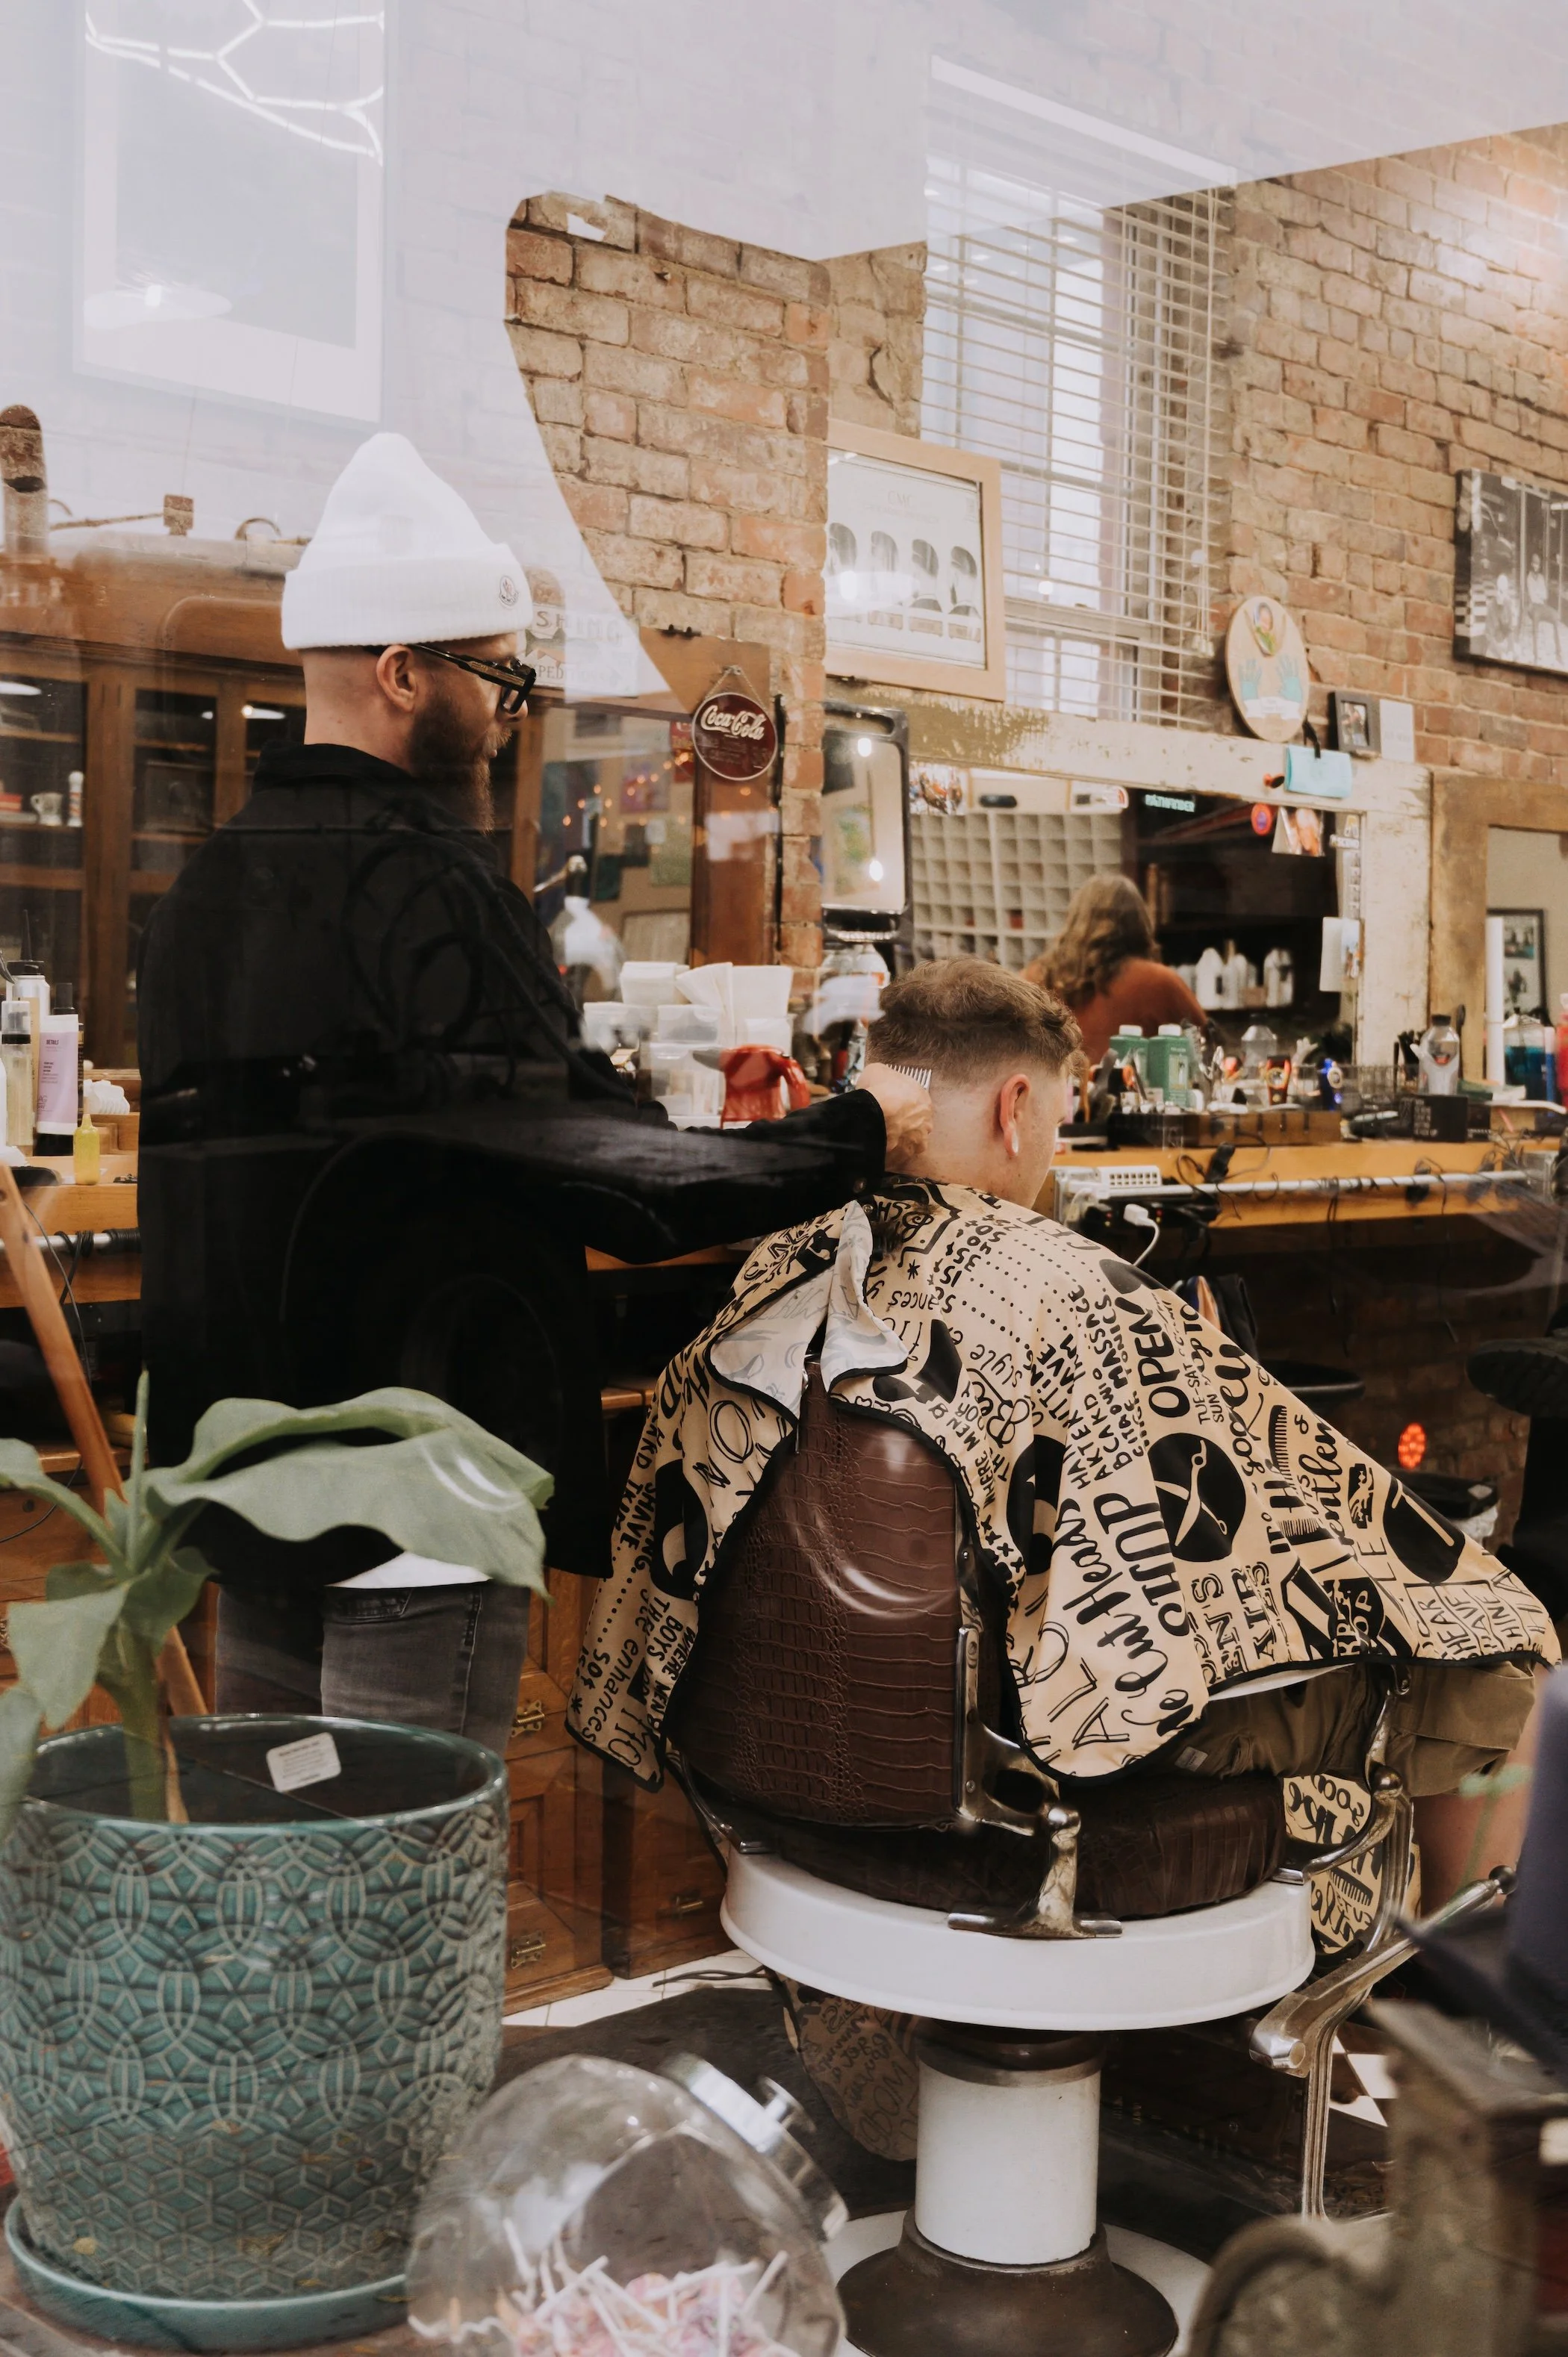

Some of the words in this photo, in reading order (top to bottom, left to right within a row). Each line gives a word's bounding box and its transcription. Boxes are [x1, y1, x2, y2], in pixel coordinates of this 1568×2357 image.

[536, 611, 623, 647] SHING
[700, 704, 766, 740] Coca-Cola
[946, 1417, 980, 1451] MEN
[647, 1615, 683, 1661] BOYS
[582, 1639, 639, 1743] enhances
